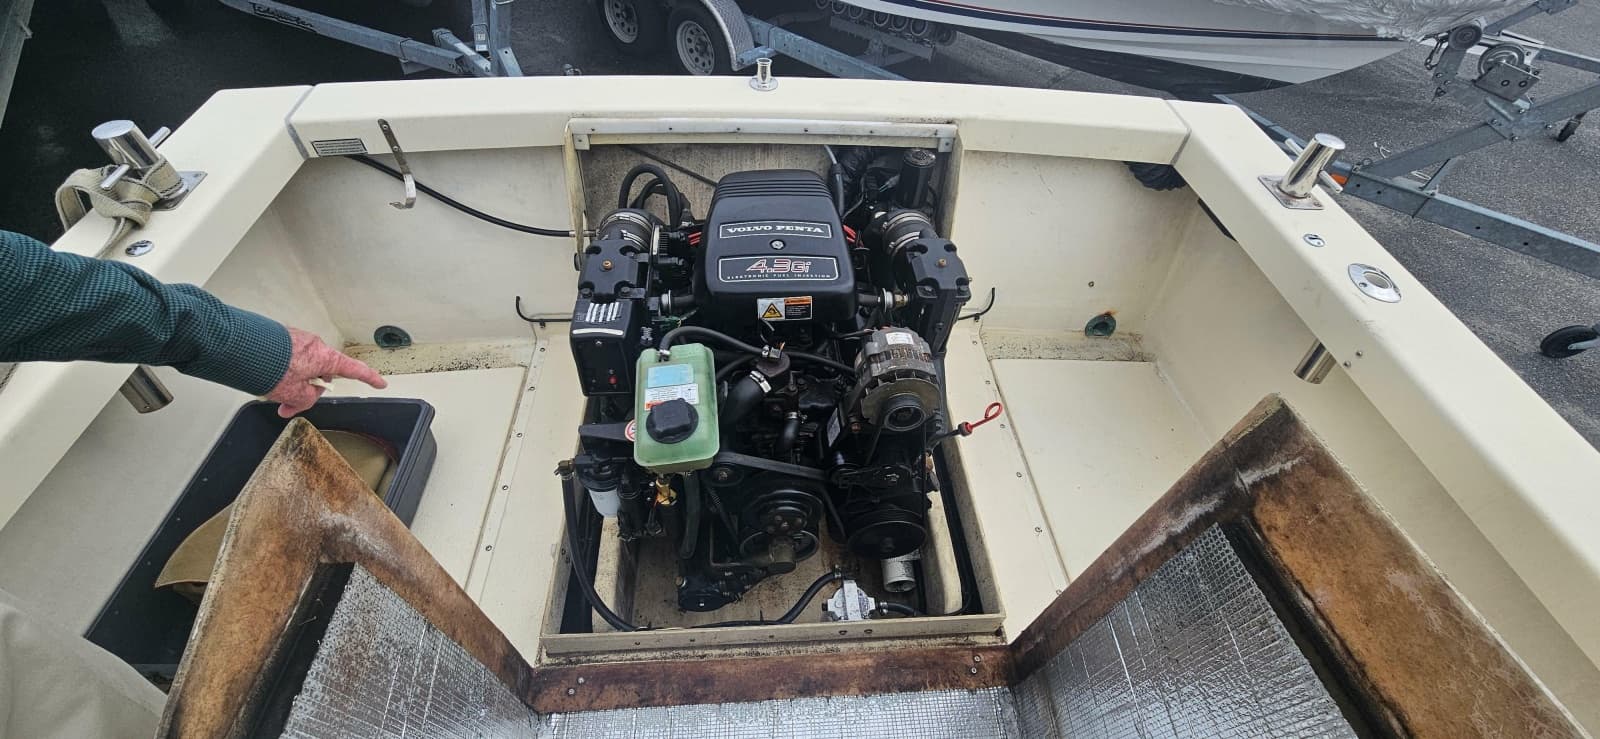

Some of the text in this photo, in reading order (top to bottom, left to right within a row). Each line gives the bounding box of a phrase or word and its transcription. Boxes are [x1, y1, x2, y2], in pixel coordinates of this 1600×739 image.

[727, 225, 825, 233] VOLVO PENTA
[745, 258, 811, 273] 4.3Gi
